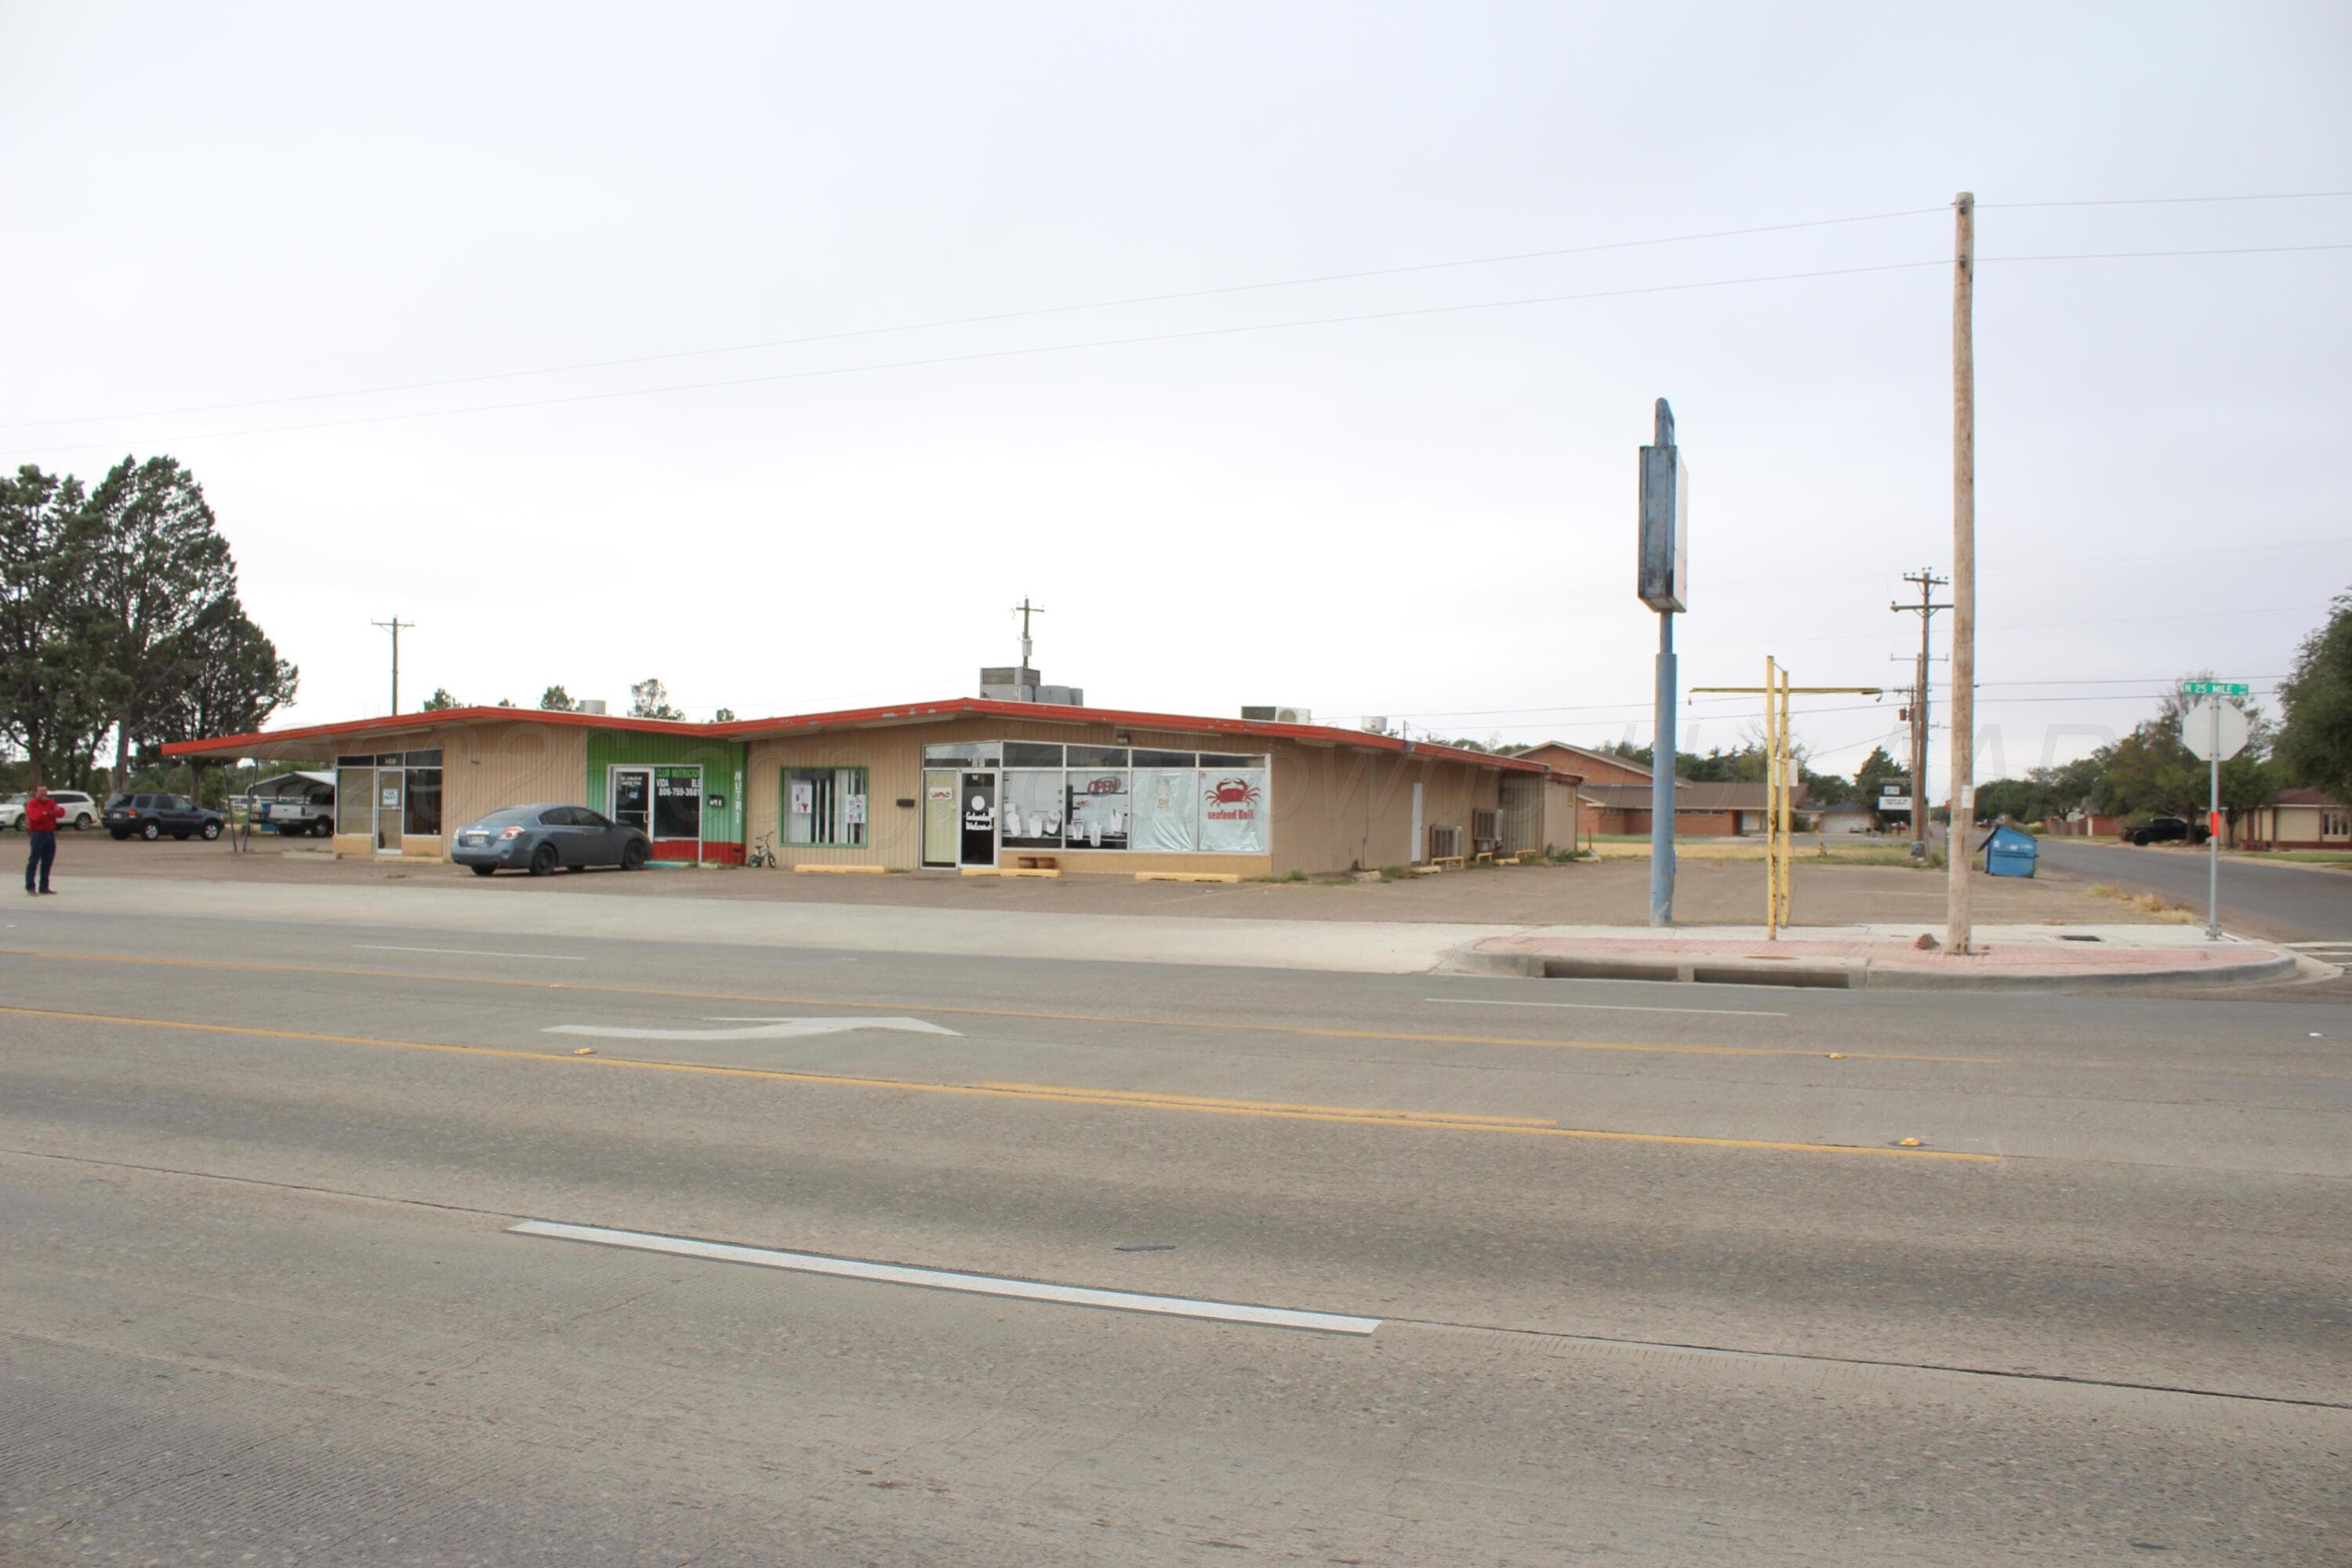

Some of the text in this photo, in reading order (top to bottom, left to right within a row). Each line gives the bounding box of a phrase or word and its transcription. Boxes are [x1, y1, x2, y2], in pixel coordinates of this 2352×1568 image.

[2185, 683, 2192, 692] N
[2194, 684, 2207, 693] 25
[2212, 684, 2233, 694] MILE
[656, 778, 669, 788] VIDA
[1087, 780, 1117, 793] OPEN
